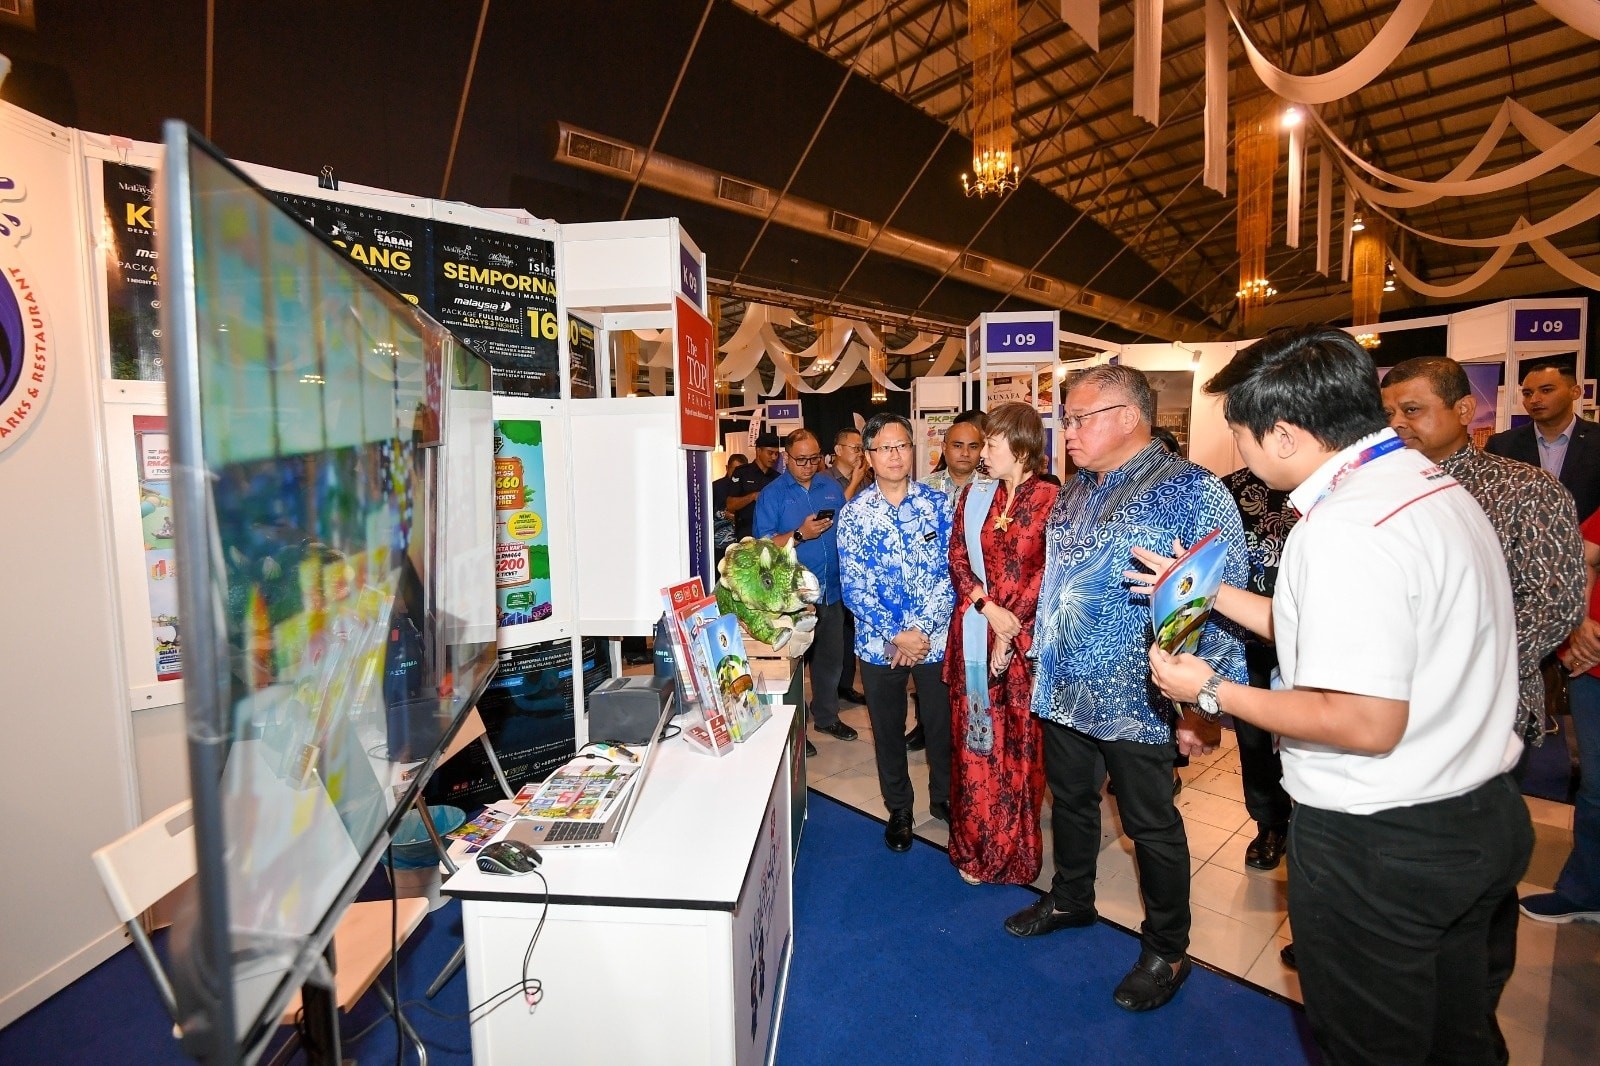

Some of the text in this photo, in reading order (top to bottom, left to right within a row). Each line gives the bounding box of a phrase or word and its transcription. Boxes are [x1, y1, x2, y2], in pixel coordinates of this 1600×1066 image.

[326, 205, 350, 214] SDN
[359, 212, 382, 221] BHD
[377, 234, 413, 248] SABAH
[331, 240, 411, 271] ANG
[443, 261, 557, 297] SEMPORNA
[683, 264, 697, 294] K 09
[458, 282, 484, 292] BOHEY
[486, 286, 516, 297] DULANG
[453, 297, 499, 310] malaysia
[441, 307, 477, 318] PACKAGE
[478, 312, 520, 324] FULLBOARD
[469, 317, 489, 326] DAYS
[495, 320, 520, 330] NIGHTS
[8, 266, 47, 383] RESTAURANT
[1529, 320, 1564, 333] J 09
[685, 335, 698, 357] The
[1003, 334, 1036, 346] J 09
[686, 355, 706, 391] TOP
[28, 387, 39, 399] &
